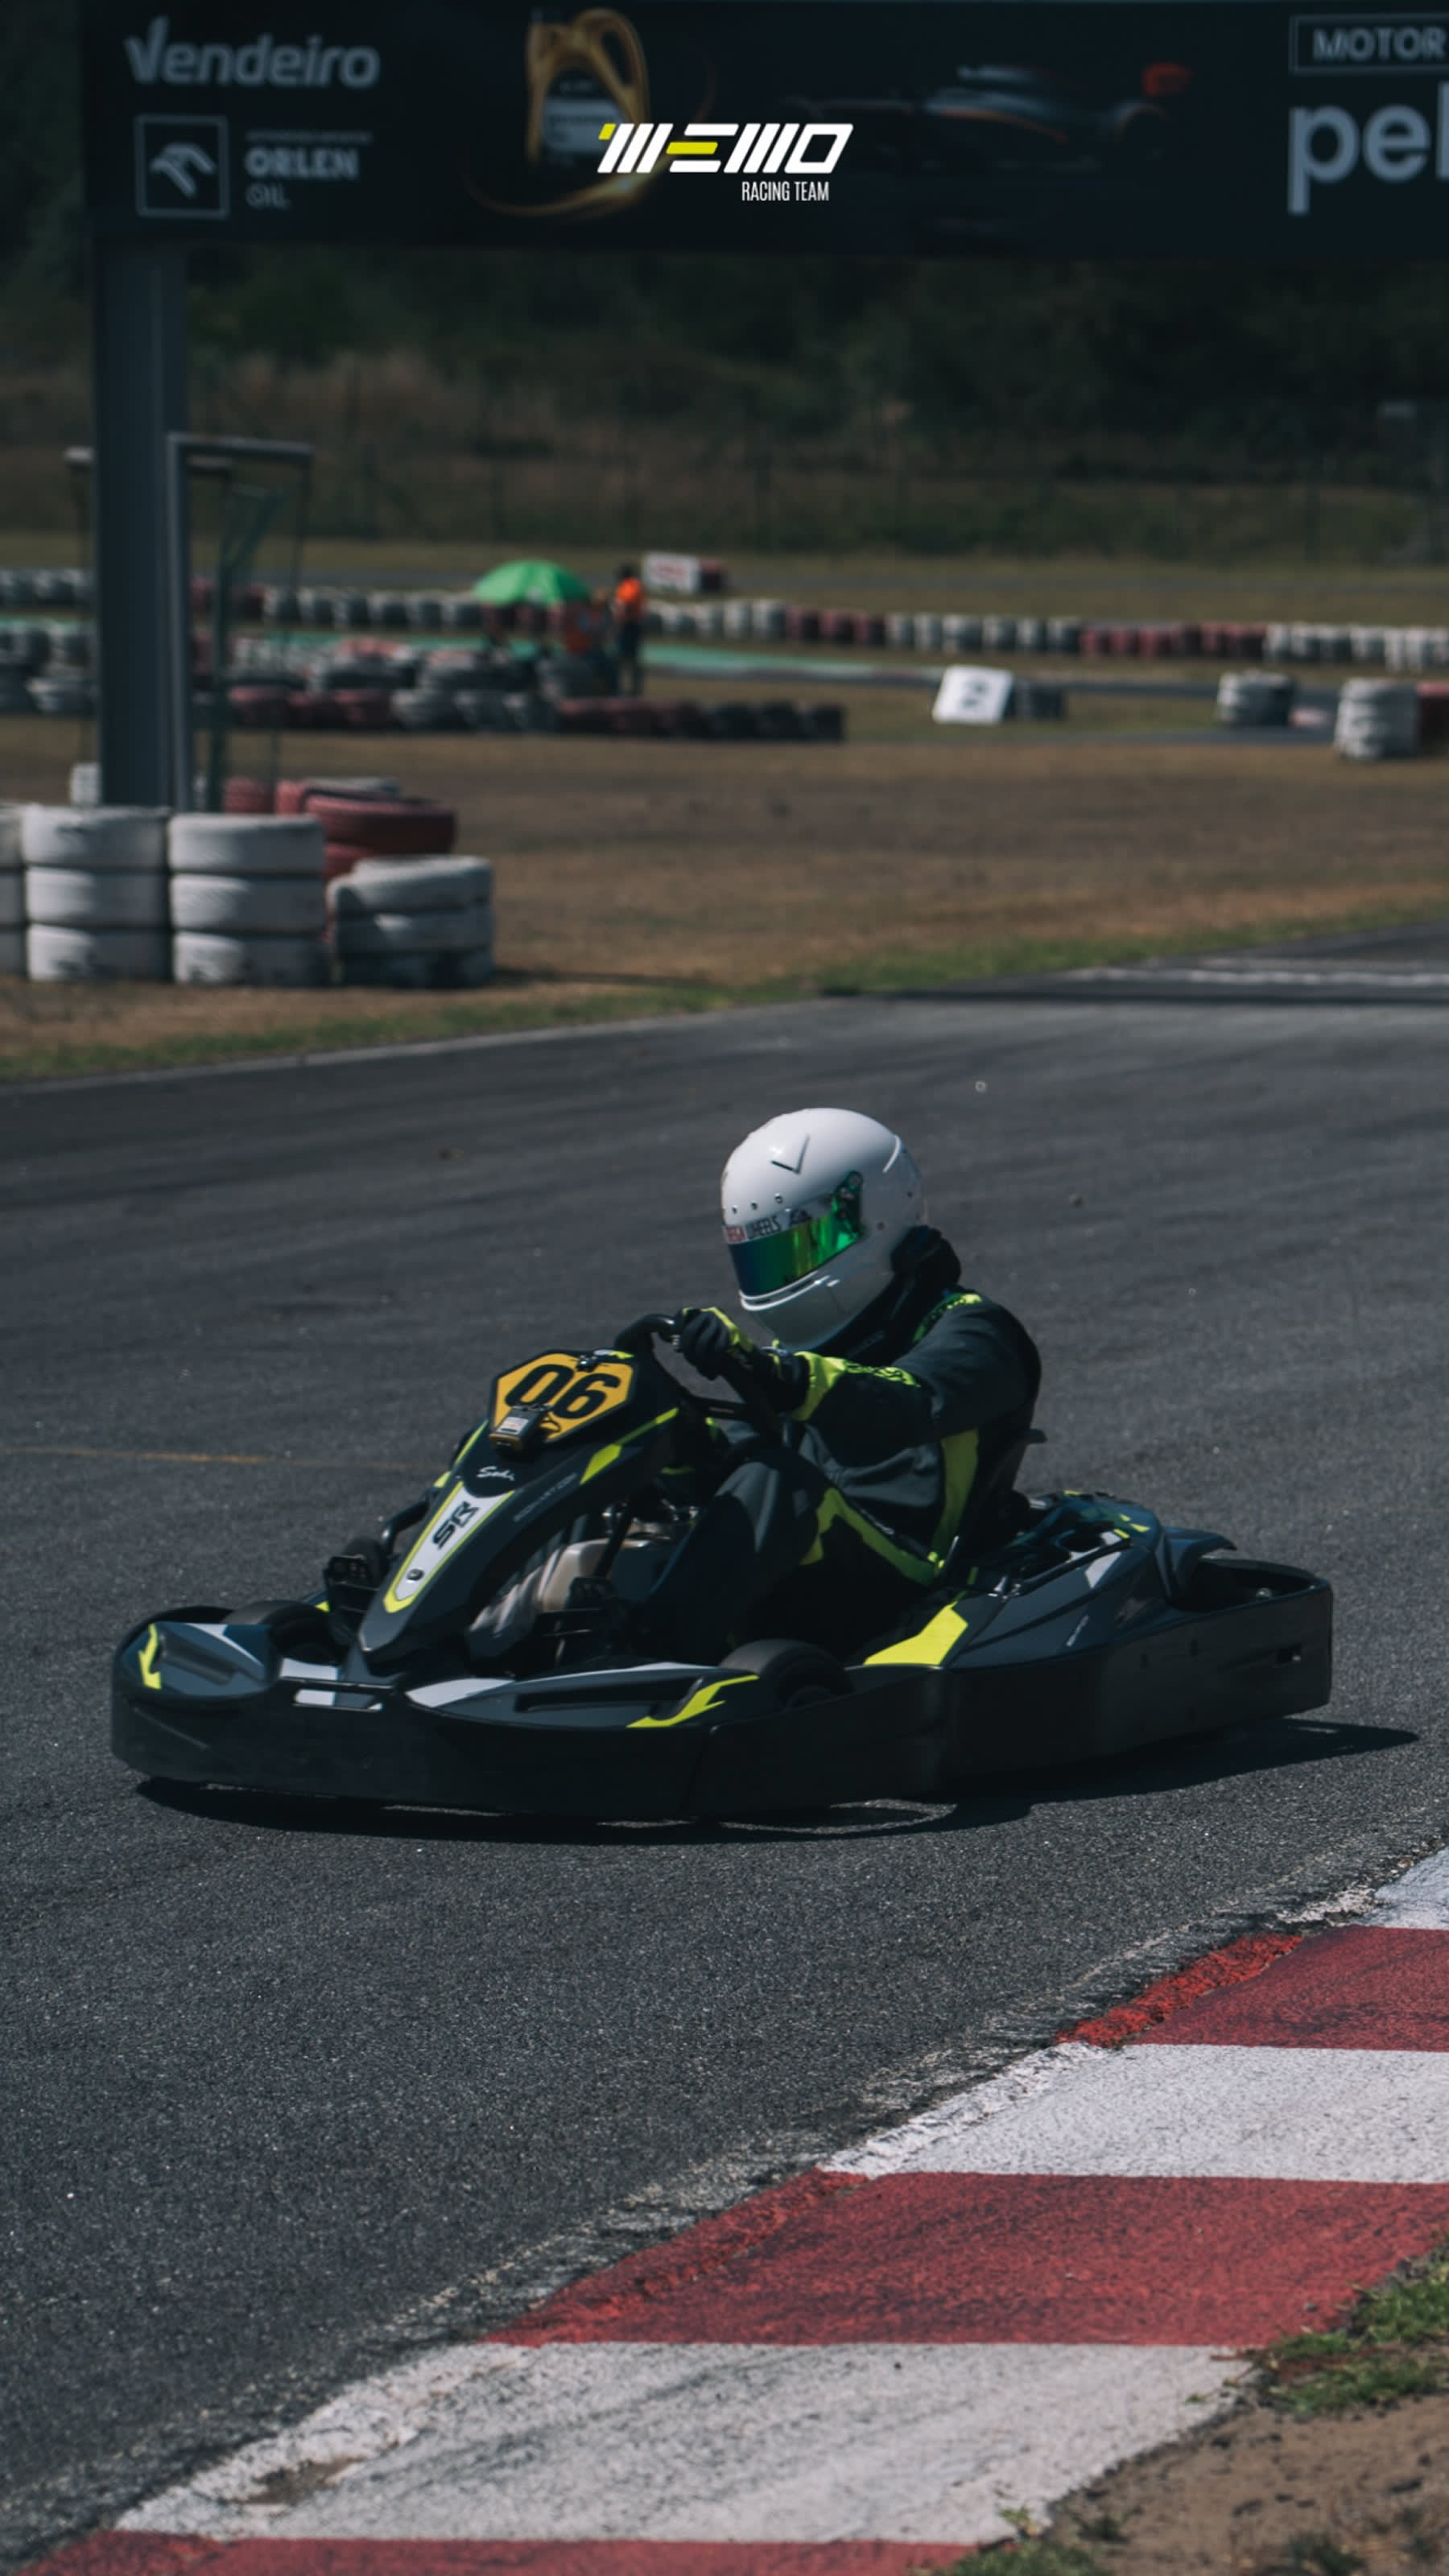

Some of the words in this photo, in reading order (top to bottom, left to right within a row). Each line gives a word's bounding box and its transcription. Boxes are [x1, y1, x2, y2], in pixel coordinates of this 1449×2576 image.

[123, 16, 381, 86] Vendeiro
[1312, 26, 1447, 61] MOTOR
[245, 147, 359, 179] ORLEN
[505, 1364, 621, 1418] 06
